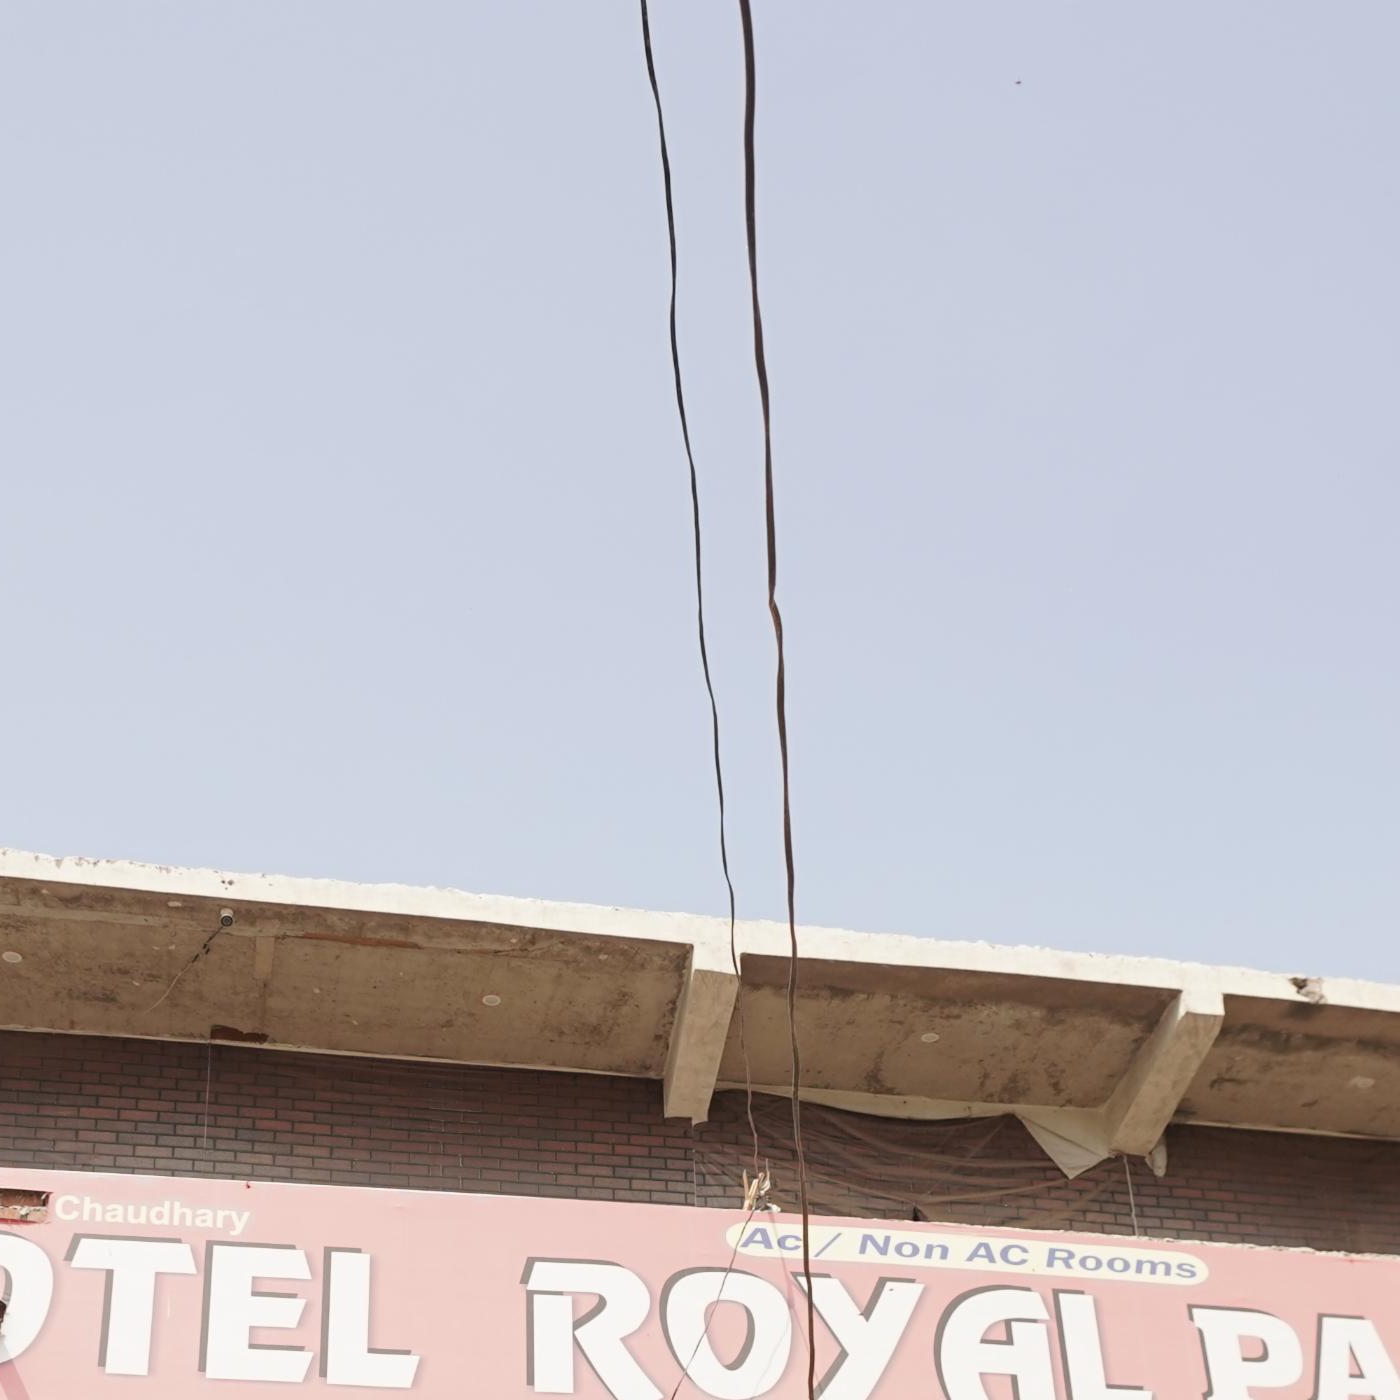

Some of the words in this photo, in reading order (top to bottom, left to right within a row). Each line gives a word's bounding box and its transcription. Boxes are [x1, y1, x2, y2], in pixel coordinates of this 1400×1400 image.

[55, 1195, 251, 1236] Chaudhary
[740, 1226, 803, 1252] Ac
[857, 1233, 951, 1261] Non
[963, 1240, 1030, 1267] AC
[1045, 1247, 1198, 1280] Rooms
